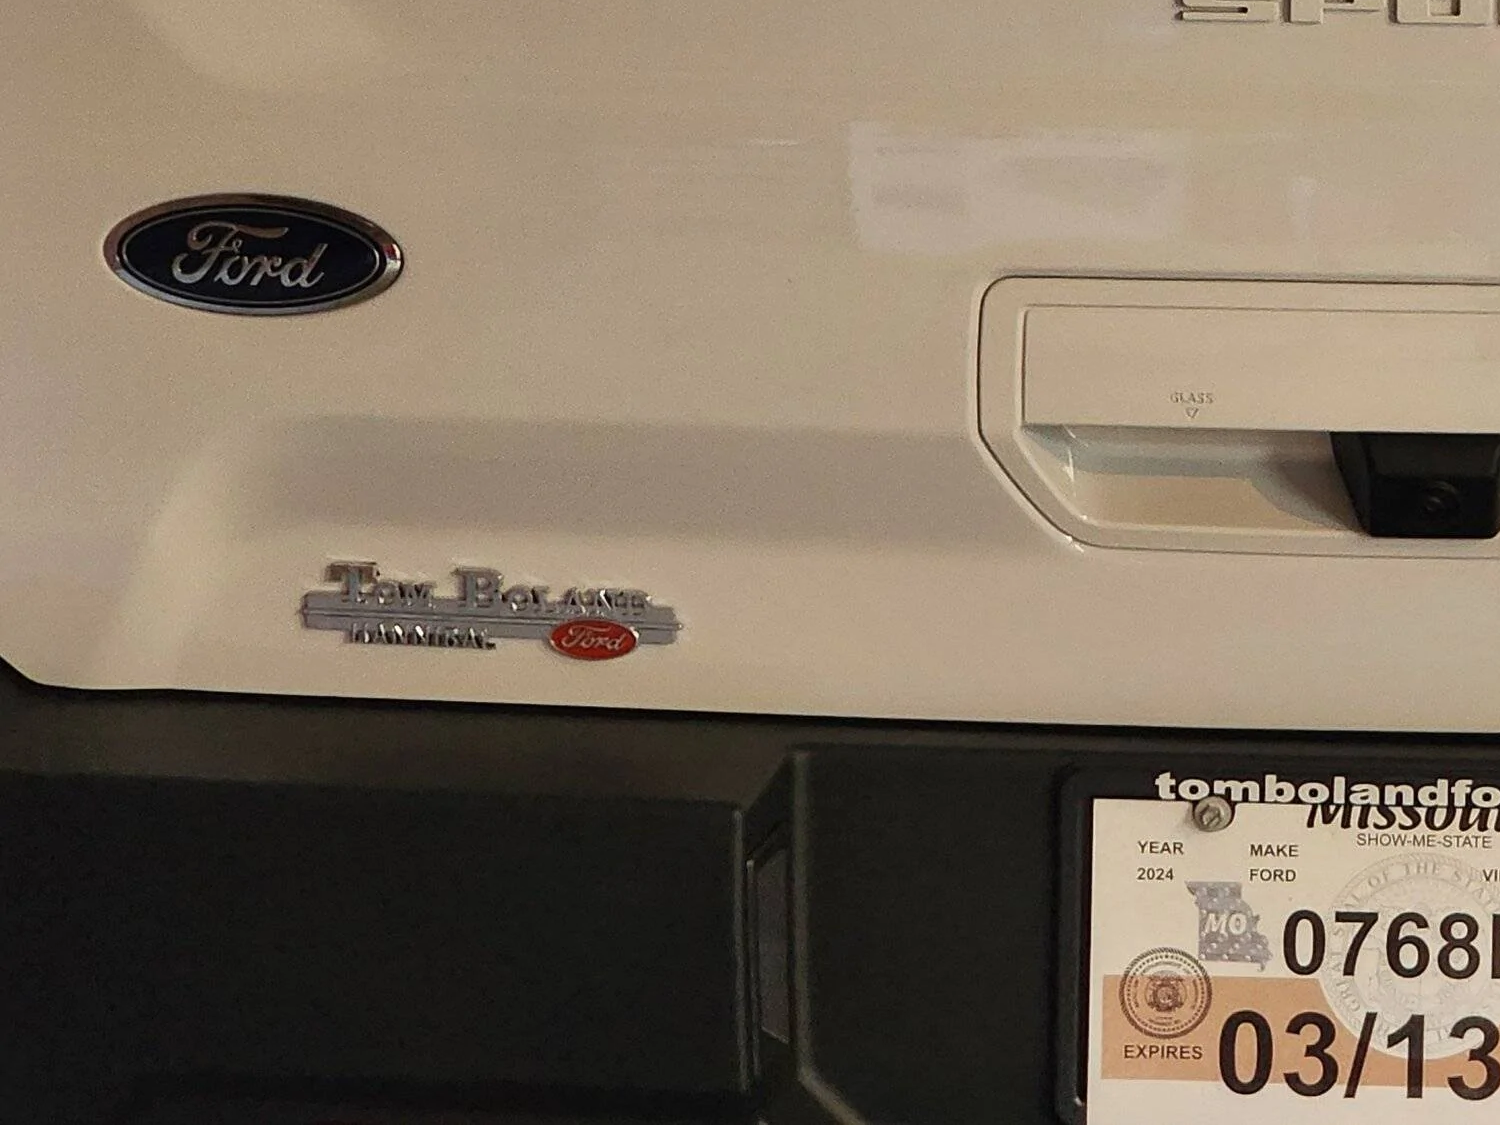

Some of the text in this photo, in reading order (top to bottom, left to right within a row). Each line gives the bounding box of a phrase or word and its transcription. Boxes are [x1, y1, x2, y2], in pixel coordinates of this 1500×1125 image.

[172, 220, 329, 288] Ford
[1169, 392, 1215, 405] GLASS
[561, 624, 629, 653] Ford
[1137, 840, 1185, 855] YEAR
[1356, 832, 1494, 850] SHOW-ME-STATE
[1249, 843, 1300, 858] MAKE
[1136, 867, 1175, 881] 2024
[1249, 868, 1297, 882] FORD
[1204, 911, 1248, 936] MO
[1123, 1043, 1204, 1060] EXPIRES
